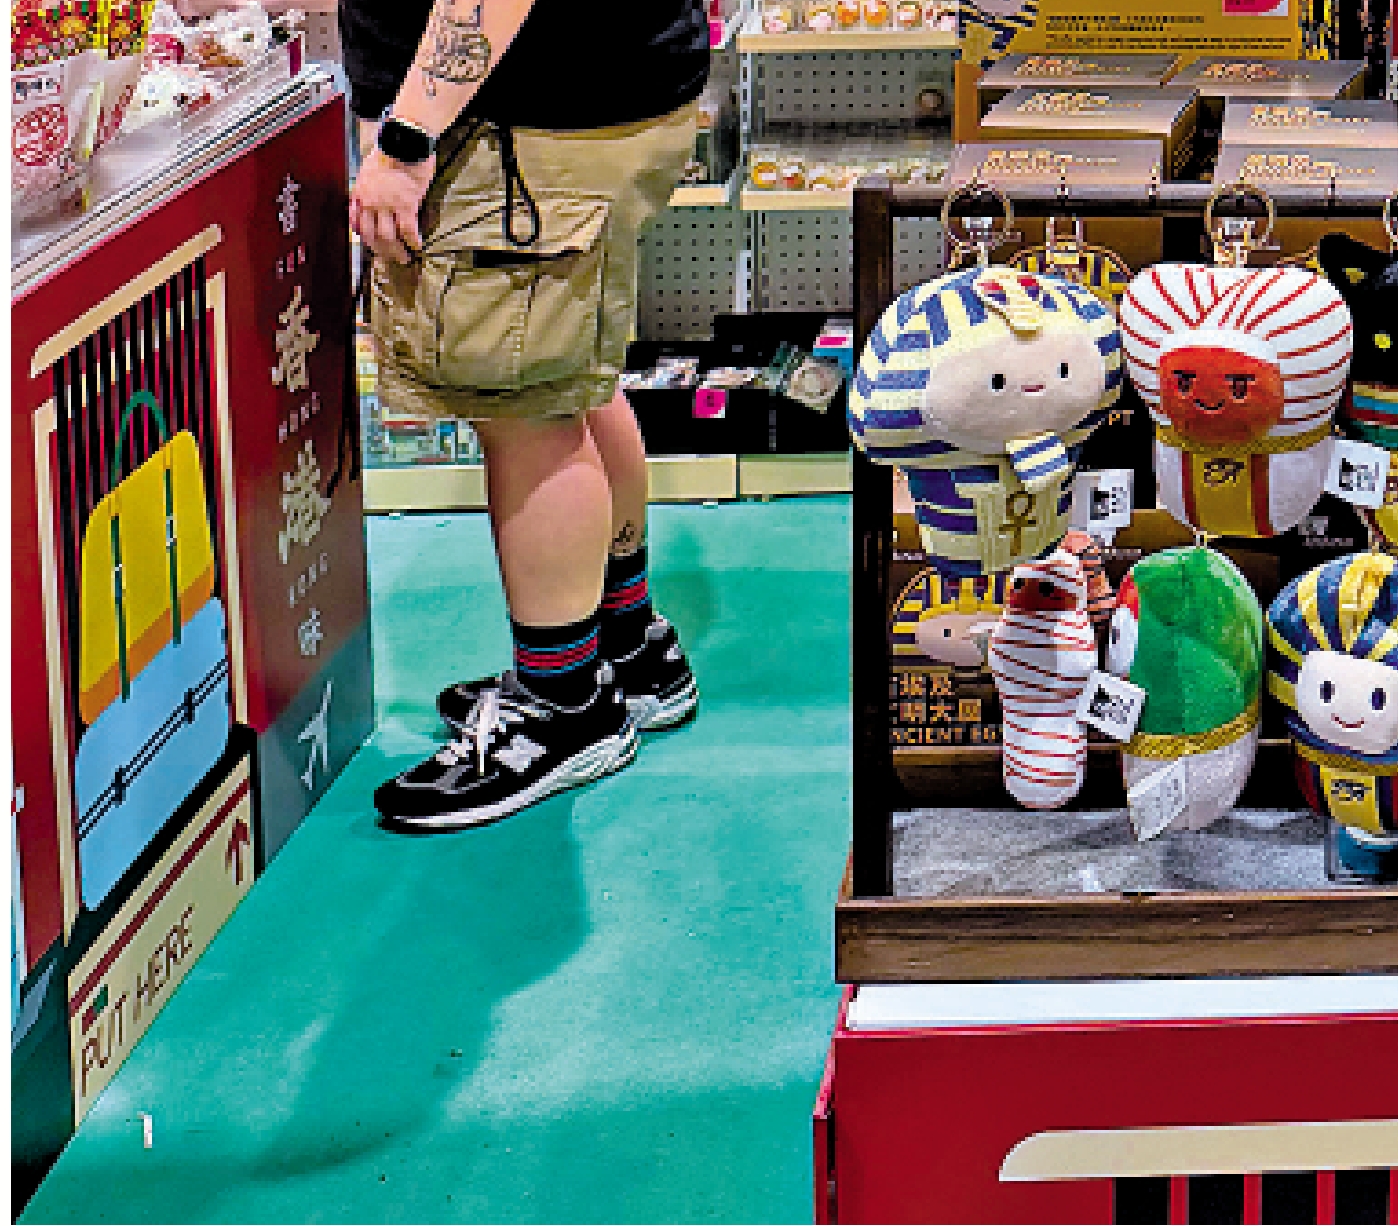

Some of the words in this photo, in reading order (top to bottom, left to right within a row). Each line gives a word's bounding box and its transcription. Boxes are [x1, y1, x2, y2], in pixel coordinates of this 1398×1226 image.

[270, 284, 321, 394] 香
[888, 672, 953, 697] 埃及
[80, 992, 128, 1097] PUT
[133, 904, 195, 1023] HERE
